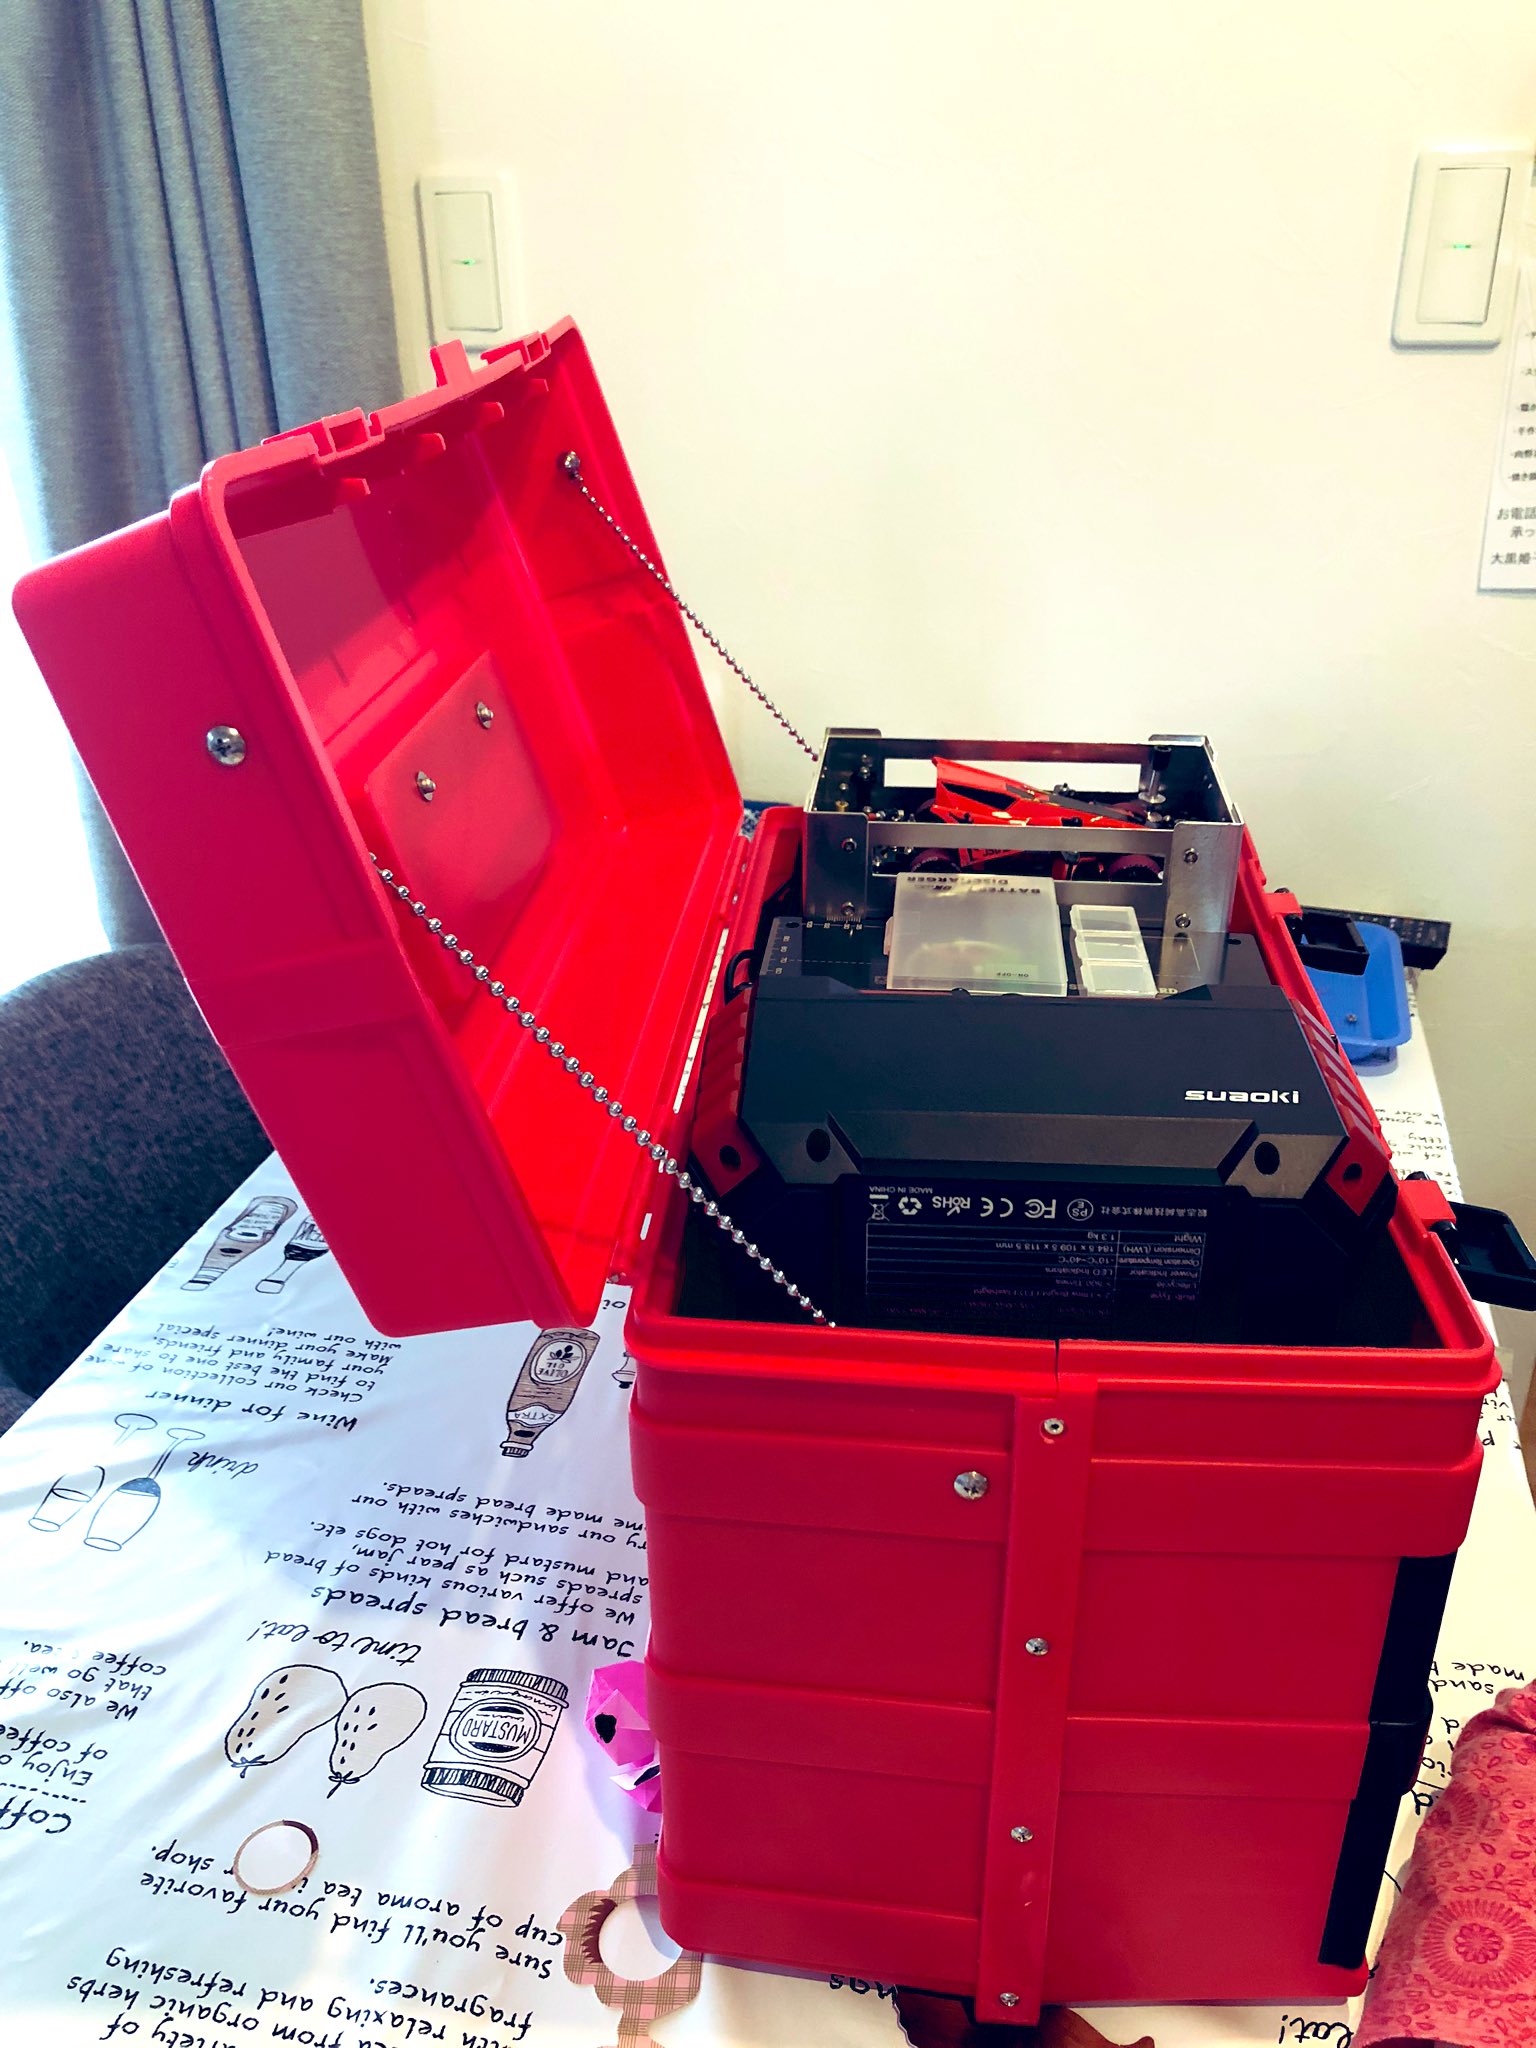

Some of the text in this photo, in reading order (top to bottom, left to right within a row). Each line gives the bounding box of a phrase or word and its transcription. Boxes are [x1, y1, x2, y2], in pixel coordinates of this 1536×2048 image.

[1185, 1090, 1300, 1104] suaoki
[1154, 1246, 1200, 1254] Dimension
[155, 1323, 391, 1365] Make your dinner special
[268, 1326, 401, 1350] with our wine!
[153, 1335, 385, 1375] your family and friends.
[546, 1362, 565, 1370] OIL
[104, 1344, 375, 1391] to find the best one to share
[128, 1363, 153, 1372] of
[163, 1366, 257, 1386] collection
[538, 1368, 568, 1378] OLIVE
[264, 1381, 297, 1395] our
[304, 1386, 363, 1403] Check
[144, 1390, 357, 1432] Wine for dinner
[514, 1412, 555, 1422] EXTRA
[187, 1452, 258, 1479] drink
[351, 1495, 388, 1506] our
[383, 1482, 467, 1502] spreads.
[399, 1502, 440, 1515] with
[475, 1497, 536, 1518] bread
[546, 1507, 603, 1523] made
[449, 1510, 569, 1534] sandwiches
[578, 1530, 616, 1543] our
[311, 1521, 648, 1586] and mustard for hot dogs etc.
[351, 1543, 642, 1604] spreads such as pear jam,
[264, 1551, 635, 1626] We offer various kinds of bread
[311, 1587, 635, 1658] Jam & bread spreads
[24, 1641, 61, 1656] ea.
[313, 1630, 351, 1656] to
[353, 1635, 421, 1666] time
[67, 1667, 100, 1682] go
[92, 1651, 167, 1676] coffee
[1451, 1662, 1524, 1681] made
[47, 1689, 96, 1708] also
[104, 1678, 152, 1701] that
[106, 1700, 138, 1721] We
[462, 1719, 531, 1744] MUSTARD
[73, 1742, 108, 1764] of
[22, 1751, 93, 1786] Enjoy
[152, 1839, 215, 1874] shop.
[322, 1880, 363, 1906] tea
[378, 1892, 460, 1916] aroma
[140, 1871, 552, 1980] Sure you'll find your favorite
[470, 1904, 503, 1930] of
[514, 1913, 563, 1947] cup
[106, 1948, 247, 2000] refreshing
[65, 1974, 139, 2013] herbs
[257, 1988, 313, 2011] and
[151, 1994, 258, 2033] organic
[327, 1996, 446, 2040] relaxing
[370, 1978, 533, 2041] fragrances.
[98, 2012, 139, 2042] of
